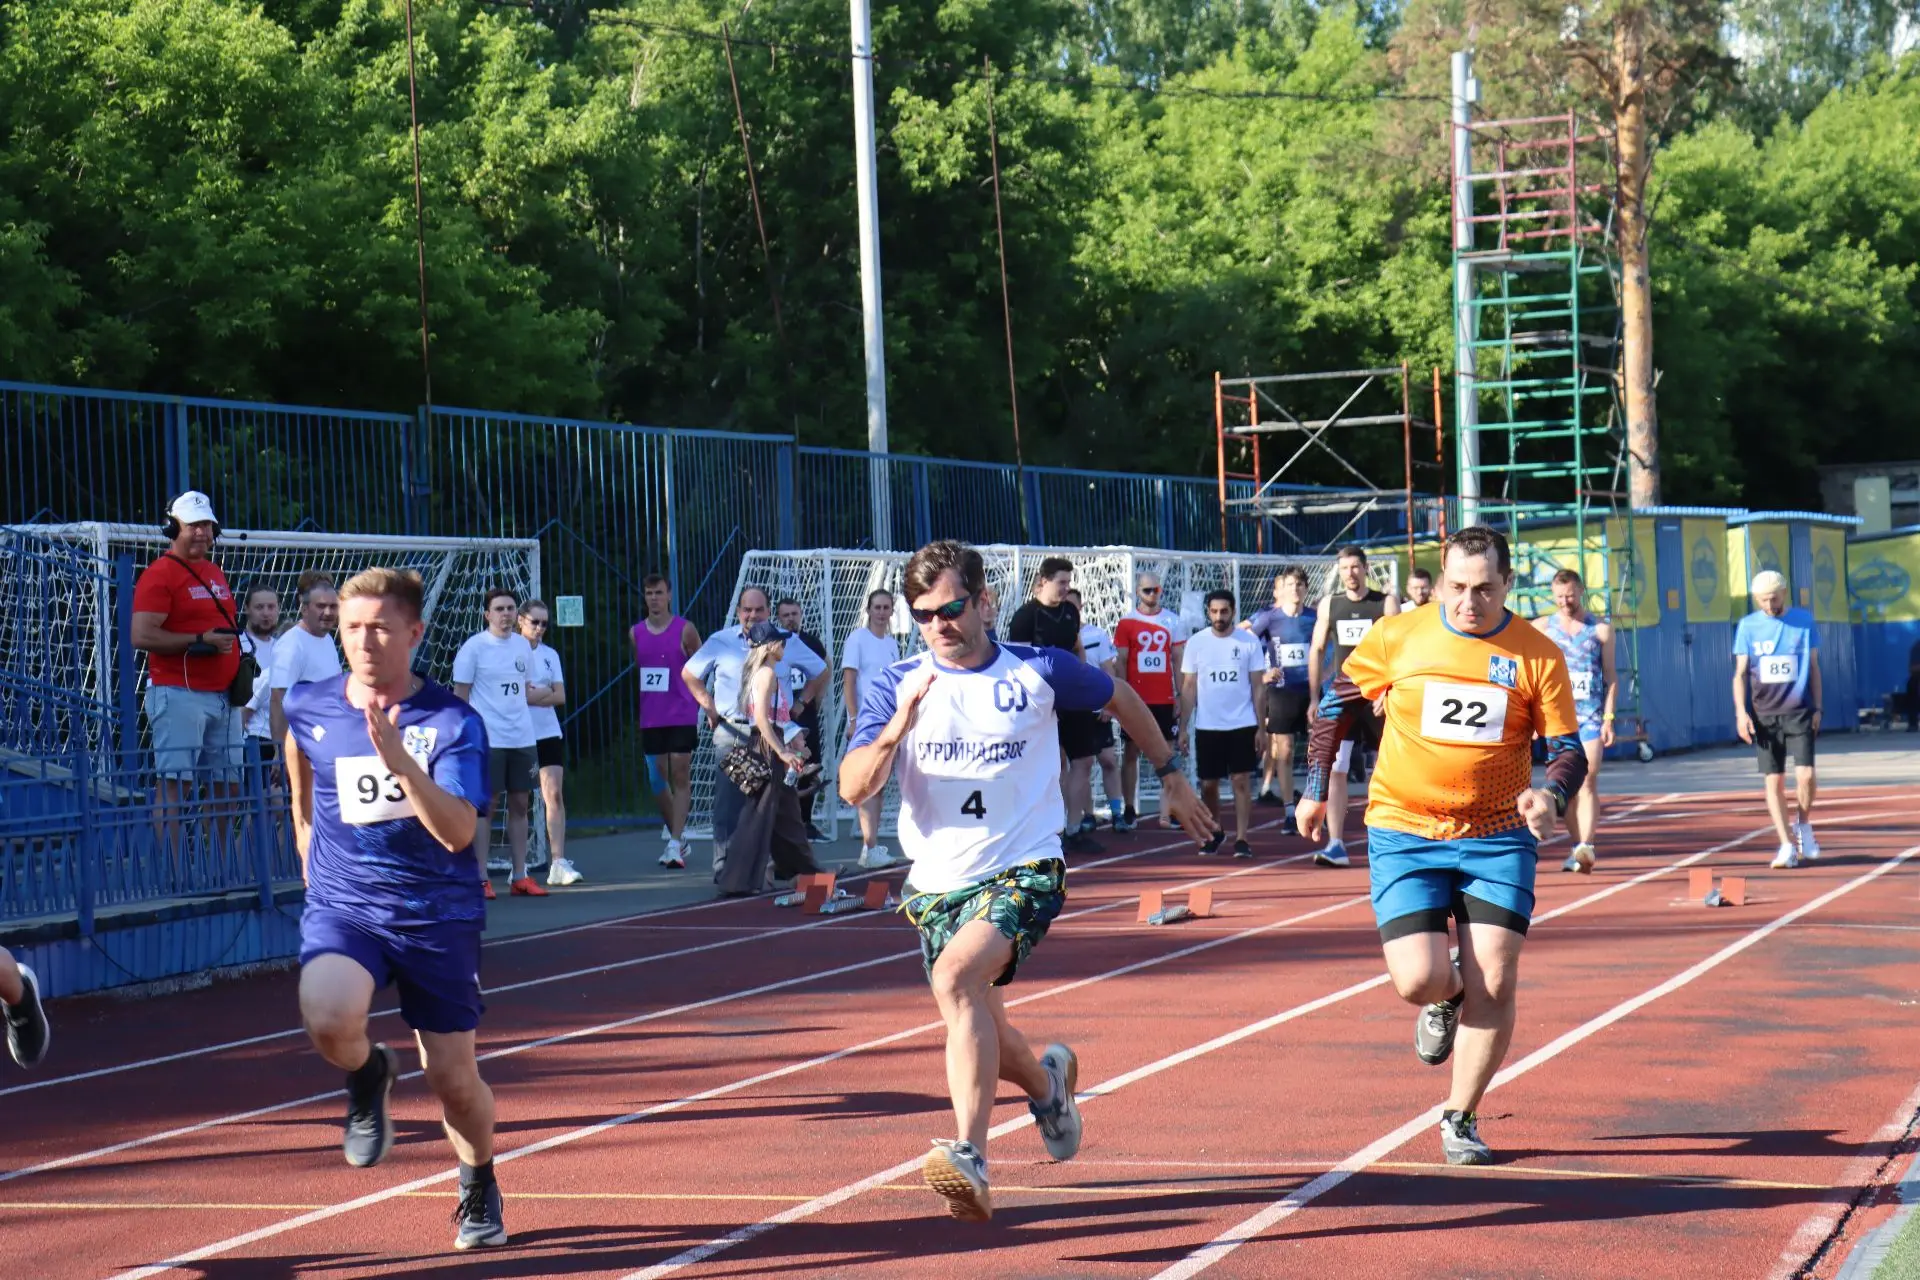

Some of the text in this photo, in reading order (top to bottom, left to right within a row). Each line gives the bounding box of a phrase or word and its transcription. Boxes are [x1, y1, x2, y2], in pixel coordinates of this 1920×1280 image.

[1346, 627, 1364, 638] 57
[1137, 630, 1168, 653] 99
[1288, 649, 1305, 660] 43
[1144, 656, 1161, 667] 60
[1770, 663, 1791, 675] 85
[646, 673, 663, 685] 27
[1209, 671, 1238, 682] 102
[501, 682, 520, 696] 79
[1440, 698, 1488, 728] 22
[357, 774, 407, 804] 93
[960, 790, 987, 820] 4
